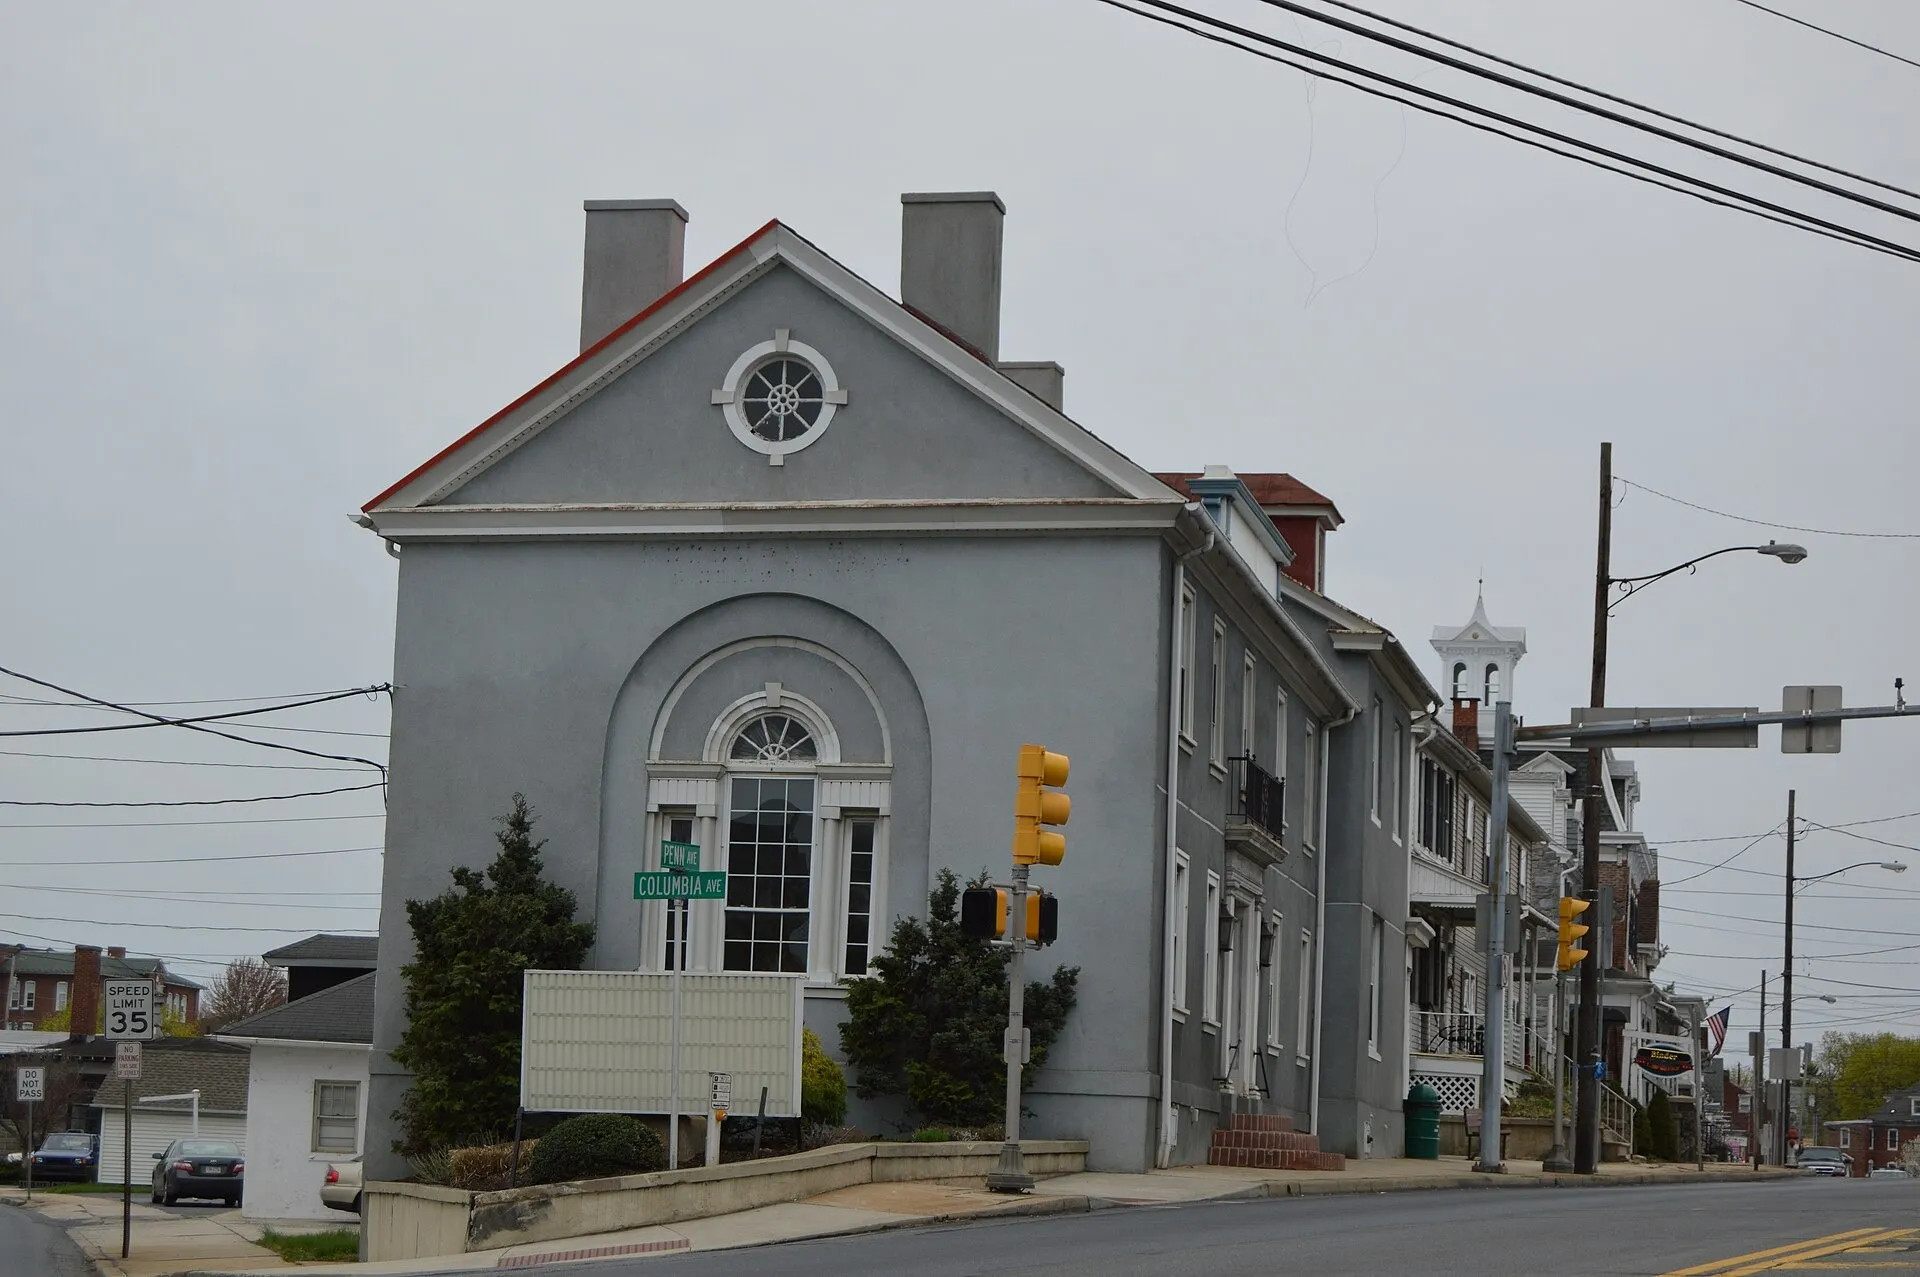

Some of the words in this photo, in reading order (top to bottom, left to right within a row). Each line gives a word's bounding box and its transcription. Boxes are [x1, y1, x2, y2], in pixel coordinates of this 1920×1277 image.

[663, 844, 685, 866] PENN
[686, 851, 697, 865] AVE
[639, 875, 702, 896] COLUMBIA
[706, 879, 722, 893] AVE
[109, 986, 150, 996] SPEED
[113, 999, 145, 1009] LIMIT
[110, 1011, 148, 1034] 35
[124, 1045, 134, 1053] NO
[118, 1054, 139, 1062] PARKING
[25, 1070, 37, 1079] DO
[22, 1080, 39, 1088] NOT
[20, 1089, 42, 1098] PASS
